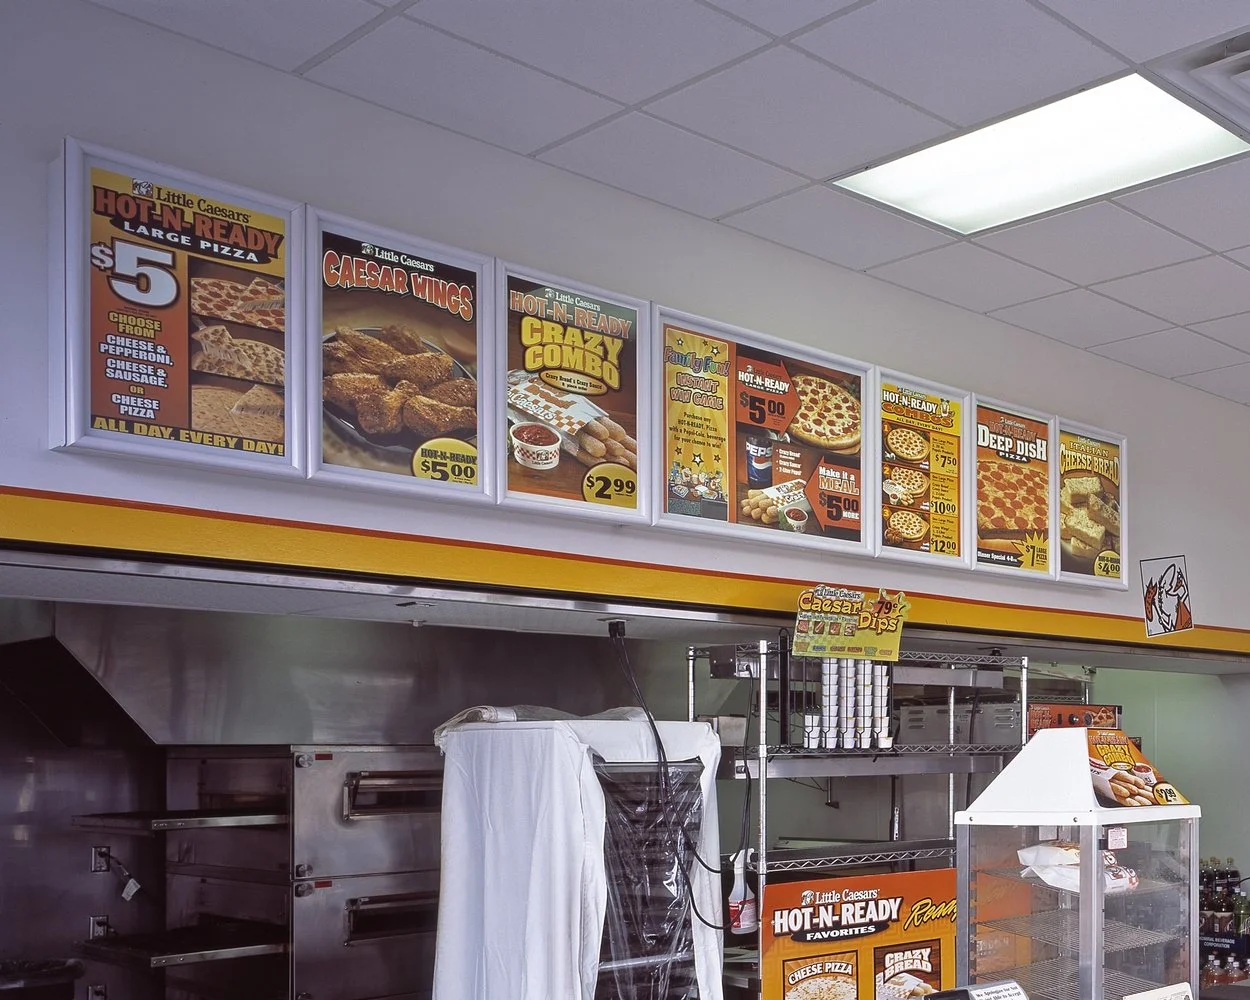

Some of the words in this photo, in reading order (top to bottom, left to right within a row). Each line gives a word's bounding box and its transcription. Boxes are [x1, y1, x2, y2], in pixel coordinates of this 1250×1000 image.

[155, 187, 194, 209] Little
[196, 198, 250, 224] Caesars
[123, 221, 192, 246] LARGE
[199, 239, 260, 263] PIZZA
[374, 247, 399, 263] Little
[400, 254, 435, 272] Caesars
[90, 237, 181, 308] $5
[322, 250, 409, 295] CAESAR
[410, 272, 474, 322] WINGS
[555, 292, 574, 306] Little
[575, 296, 601, 312] Caesars
[108, 312, 161, 331] CHOOSE
[118, 323, 155, 339] FROM
[106, 334, 155, 352] CHEESE
[156, 345, 167, 354] &
[520, 315, 624, 366] CRAZY
[106, 358, 155, 375] CHEESE
[156, 368, 167, 377] &
[524, 344, 621, 391] COMBO
[663, 345, 703, 374] Family
[703, 356, 731, 377] Fun!
[545, 372, 558, 381] Crazy
[676, 372, 719, 393] INSTANT
[130, 385, 145, 394] OR
[670, 387, 692, 404] WIN
[692, 392, 724, 410] GAME
[111, 393, 160, 410] CHEESE
[120, 404, 155, 419] PIZZA
[881, 401, 954, 429] COMBOS
[93, 416, 129, 434] ALL
[179, 428, 238, 450] EVERY
[242, 437, 284, 456] DAY!
[999, 451, 1028, 462] PIZZA
[1070, 441, 1109, 457] ITALIAN
[818, 466, 841, 478] Make
[842, 470, 848, 479] it
[1060, 442, 1092, 475] CHEESE
[1093, 455, 1120, 487] BREAD
[818, 475, 860, 496] MEAL
[842, 511, 860, 520] MORE
[799, 591, 863, 615] Caesar
[857, 611, 899, 634] Dips
[1096, 744, 1130, 757] CRAZY
[1103, 752, 1136, 767] COMBO
[815, 889, 841, 905] Little
[842, 888, 878, 901] Caesars
[806, 925, 877, 941] FAVORITES
[884, 947, 932, 967] CRAZY
[788, 964, 823, 986] CHEESE
[824, 962, 853, 976] PIZZA
[884, 959, 932, 979] BREAD
